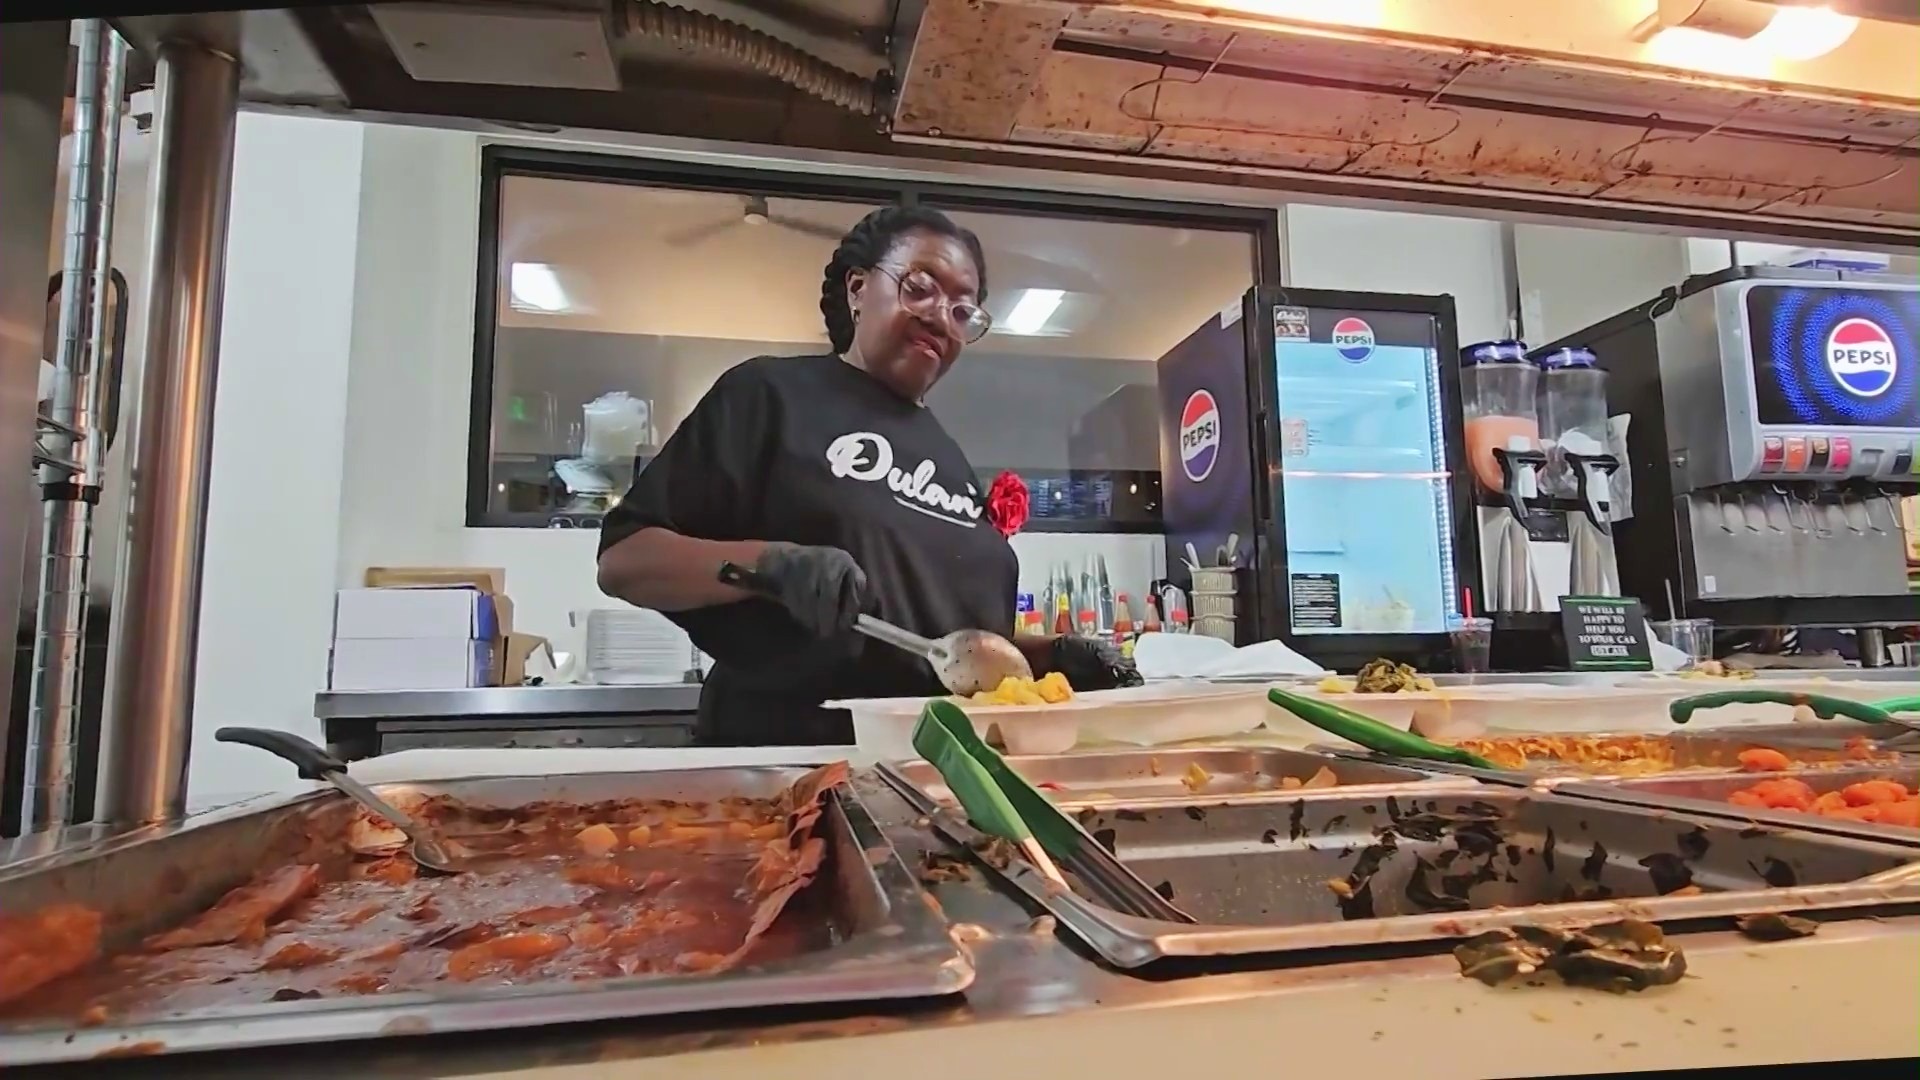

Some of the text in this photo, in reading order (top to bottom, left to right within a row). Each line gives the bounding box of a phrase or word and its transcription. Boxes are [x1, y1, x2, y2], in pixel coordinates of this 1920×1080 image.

[1335, 335, 1372, 346] PEPSI
[1833, 349, 1891, 365] PEPSI
[1183, 420, 1217, 451] PEPSI
[826, 431, 984, 519] Dulan'
[1583, 615, 1625, 624] HAPPY TO
[1607, 625, 1626, 634] YOU
[1578, 635, 1638, 644] TO YOUR CAR
